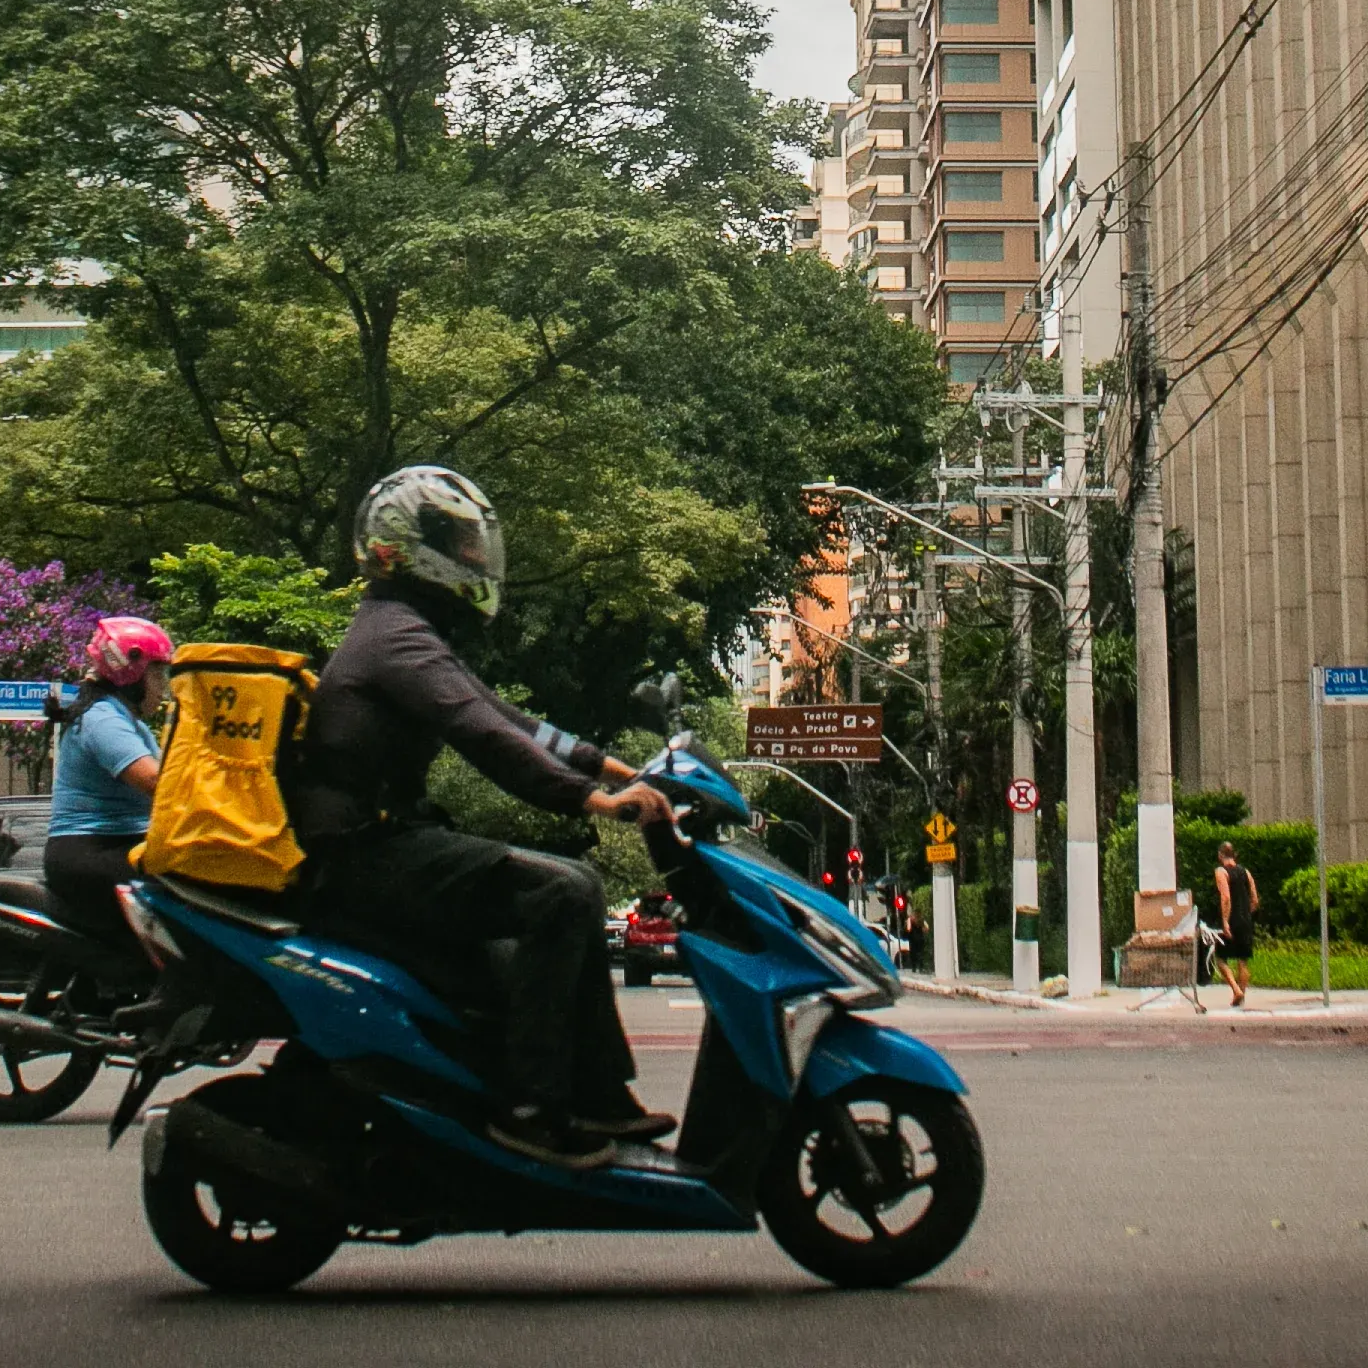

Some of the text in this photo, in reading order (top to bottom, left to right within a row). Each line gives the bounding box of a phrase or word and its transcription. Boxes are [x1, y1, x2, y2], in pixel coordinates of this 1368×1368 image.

[1325, 668, 1356, 684] Faria
[18, 685, 48, 699] Lima
[212, 686, 237, 710] 99
[803, 711, 839, 721] Teatro
[211, 715, 265, 740] Food
[754, 724, 785, 735] Décio
[806, 724, 838, 734] Prado
[812, 744, 826, 753] do
[830, 743, 858, 753] Povo
